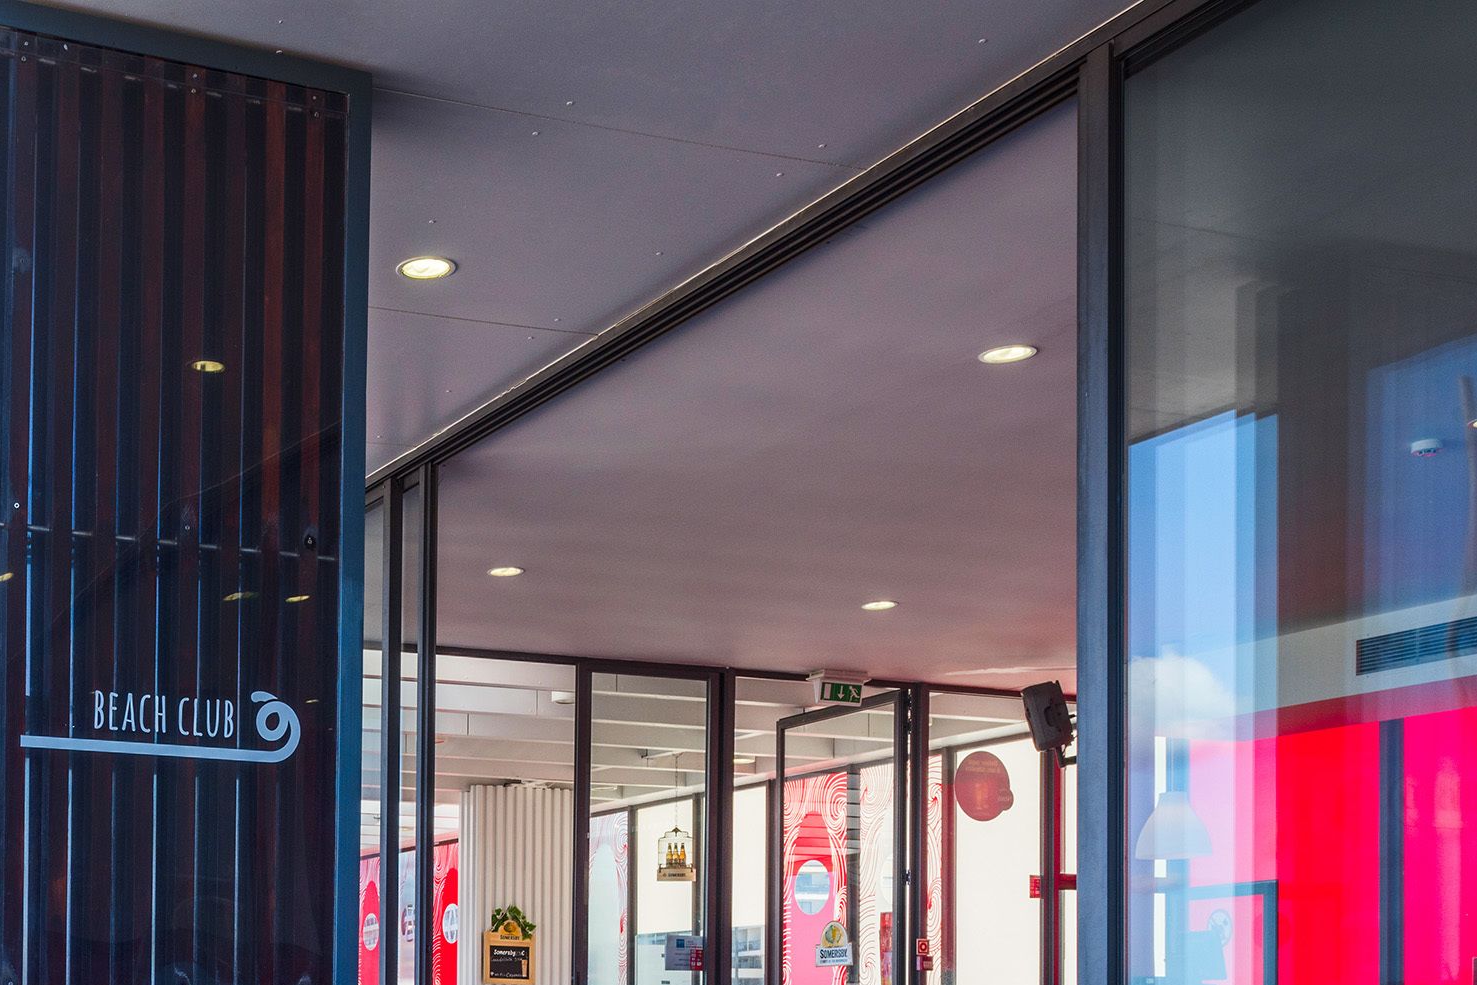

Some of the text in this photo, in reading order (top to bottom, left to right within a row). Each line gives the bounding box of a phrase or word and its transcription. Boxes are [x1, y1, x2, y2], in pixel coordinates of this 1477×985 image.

[94, 690, 234, 738] BEACH CLUB
[819, 948, 848, 959] SOMERSBY
